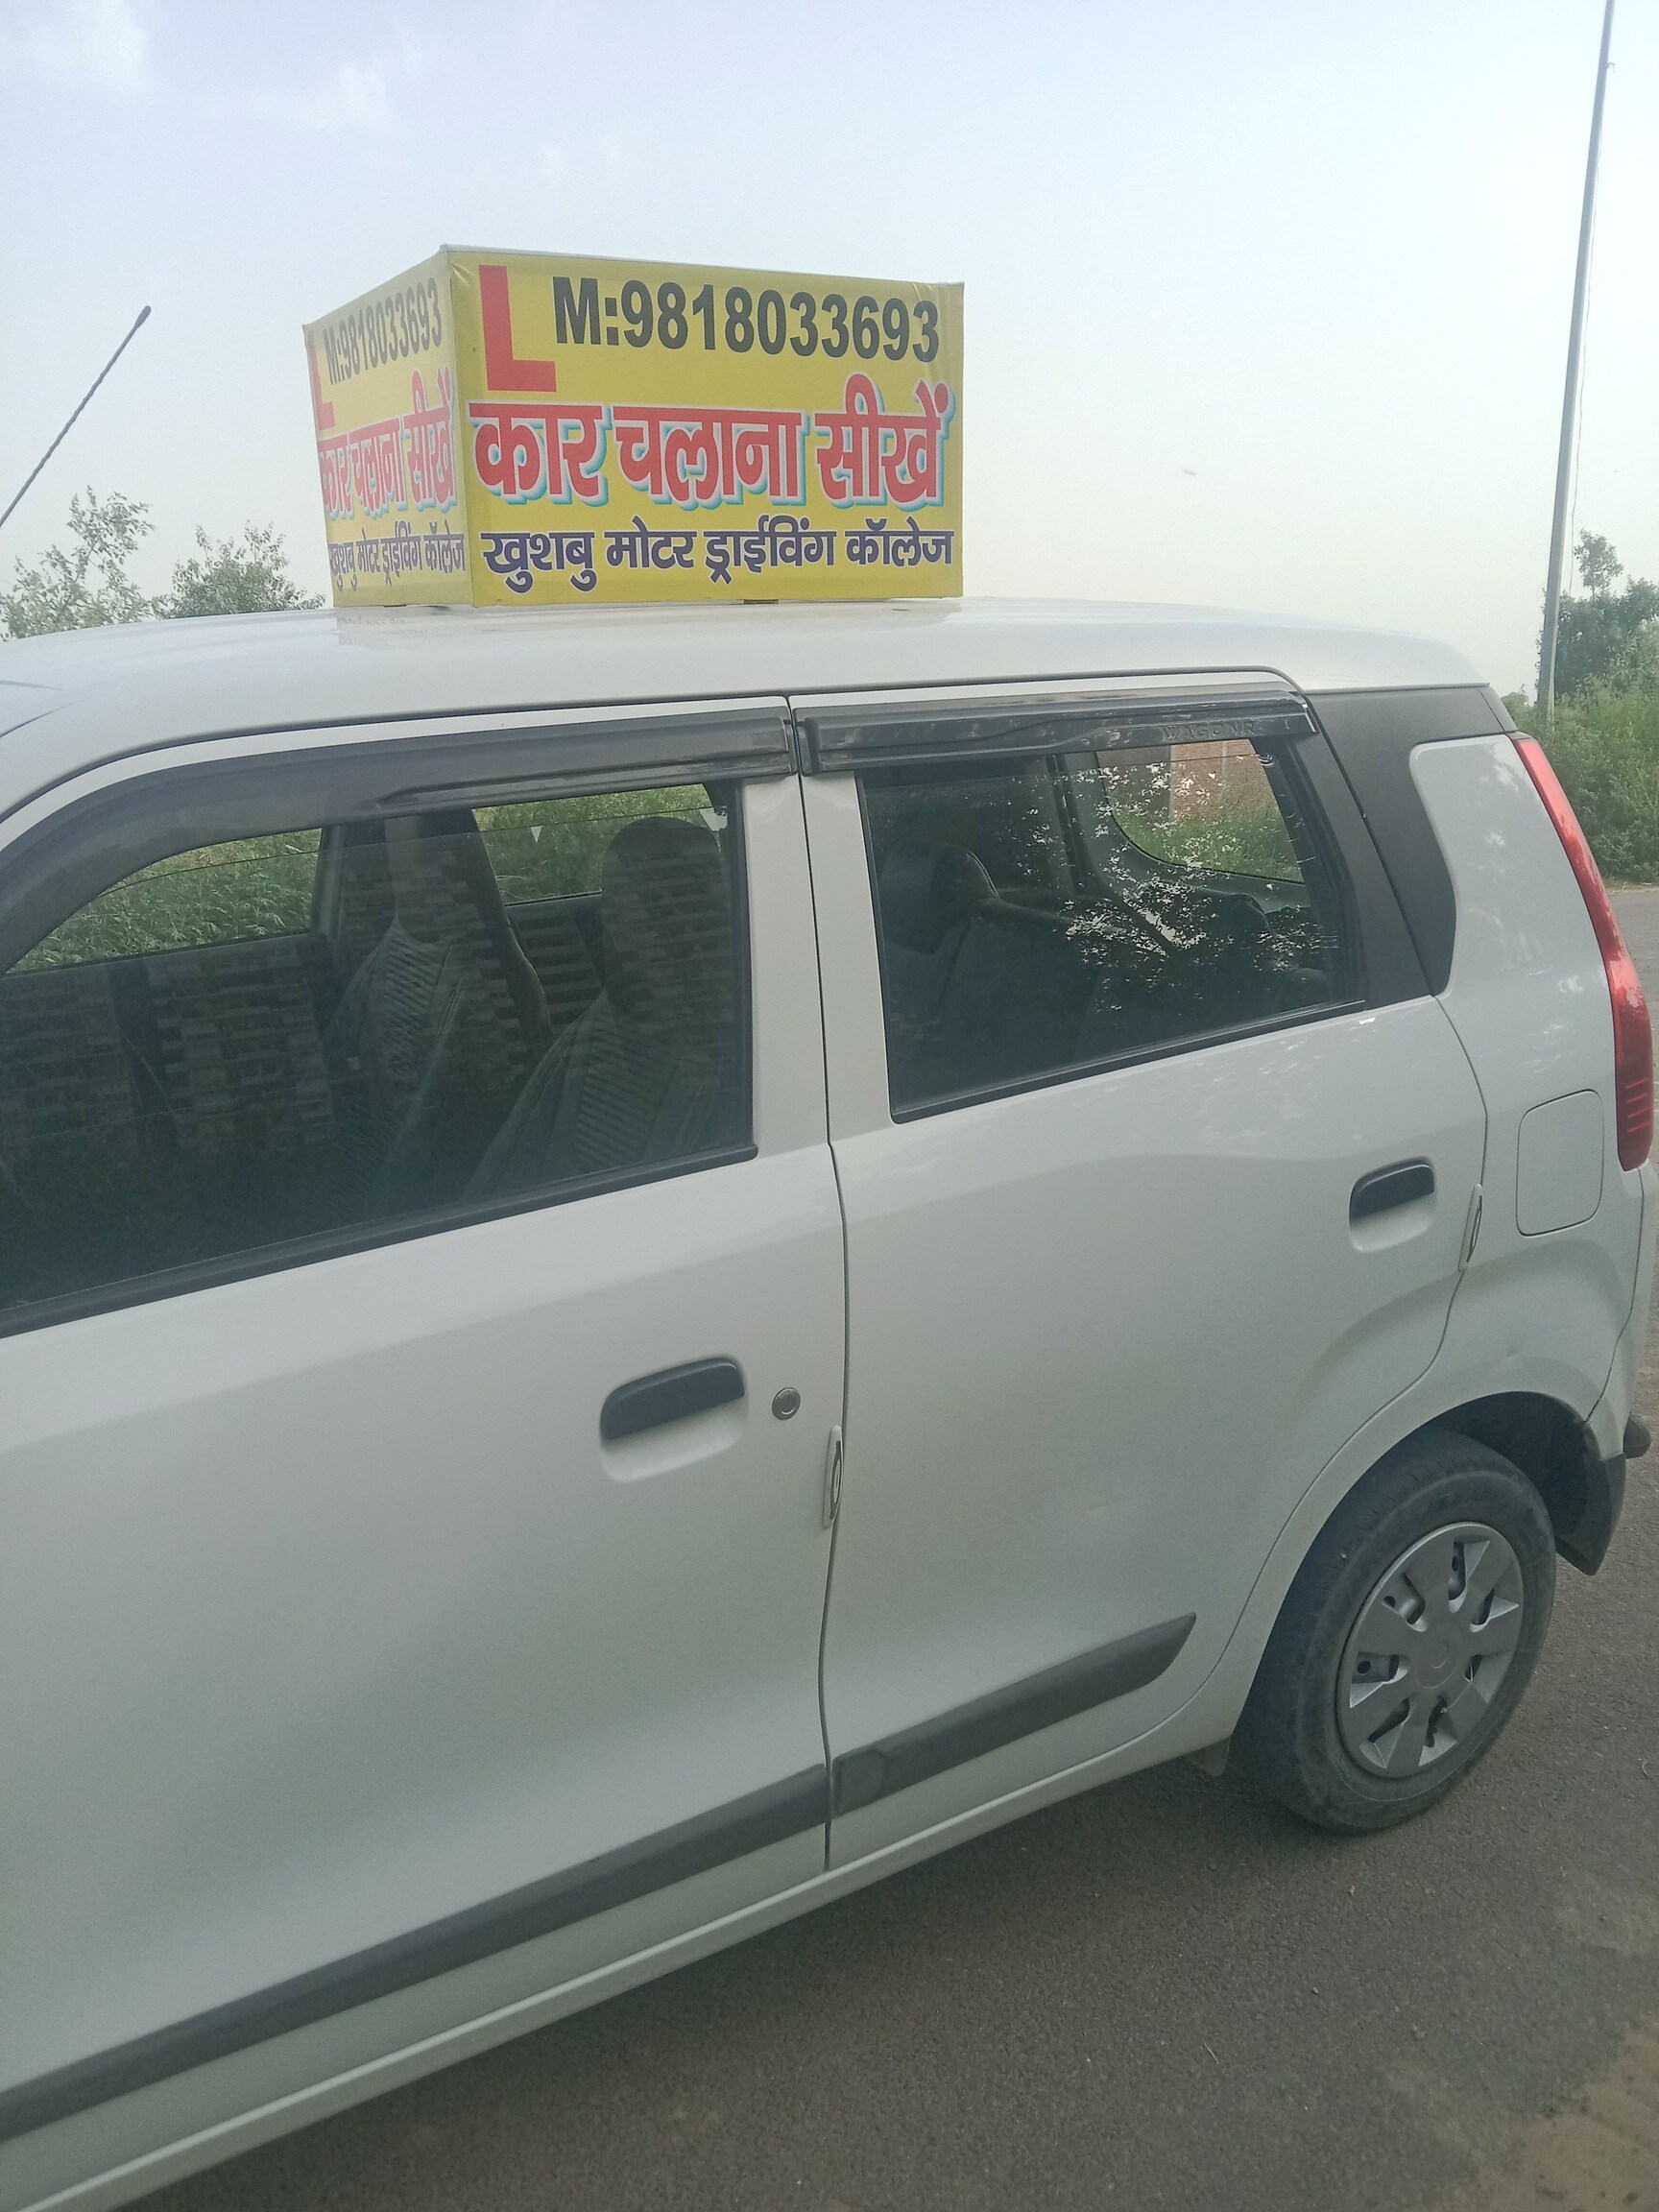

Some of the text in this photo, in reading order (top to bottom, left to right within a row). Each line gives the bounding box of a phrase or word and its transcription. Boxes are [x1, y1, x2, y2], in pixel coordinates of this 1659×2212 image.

[323, 276, 443, 386] M:9818033693
[479, 264, 941, 393] L M:9818033693
[318, 366, 457, 520] कार चलाना सीखें
[469, 373, 956, 511] कार चलाना सीखें
[356, 526, 380, 573] मोटर
[422, 518, 466, 573] कॉलेज
[481, 515, 956, 592] खुशबु मोटर ड्राईविंग कॉलेज
